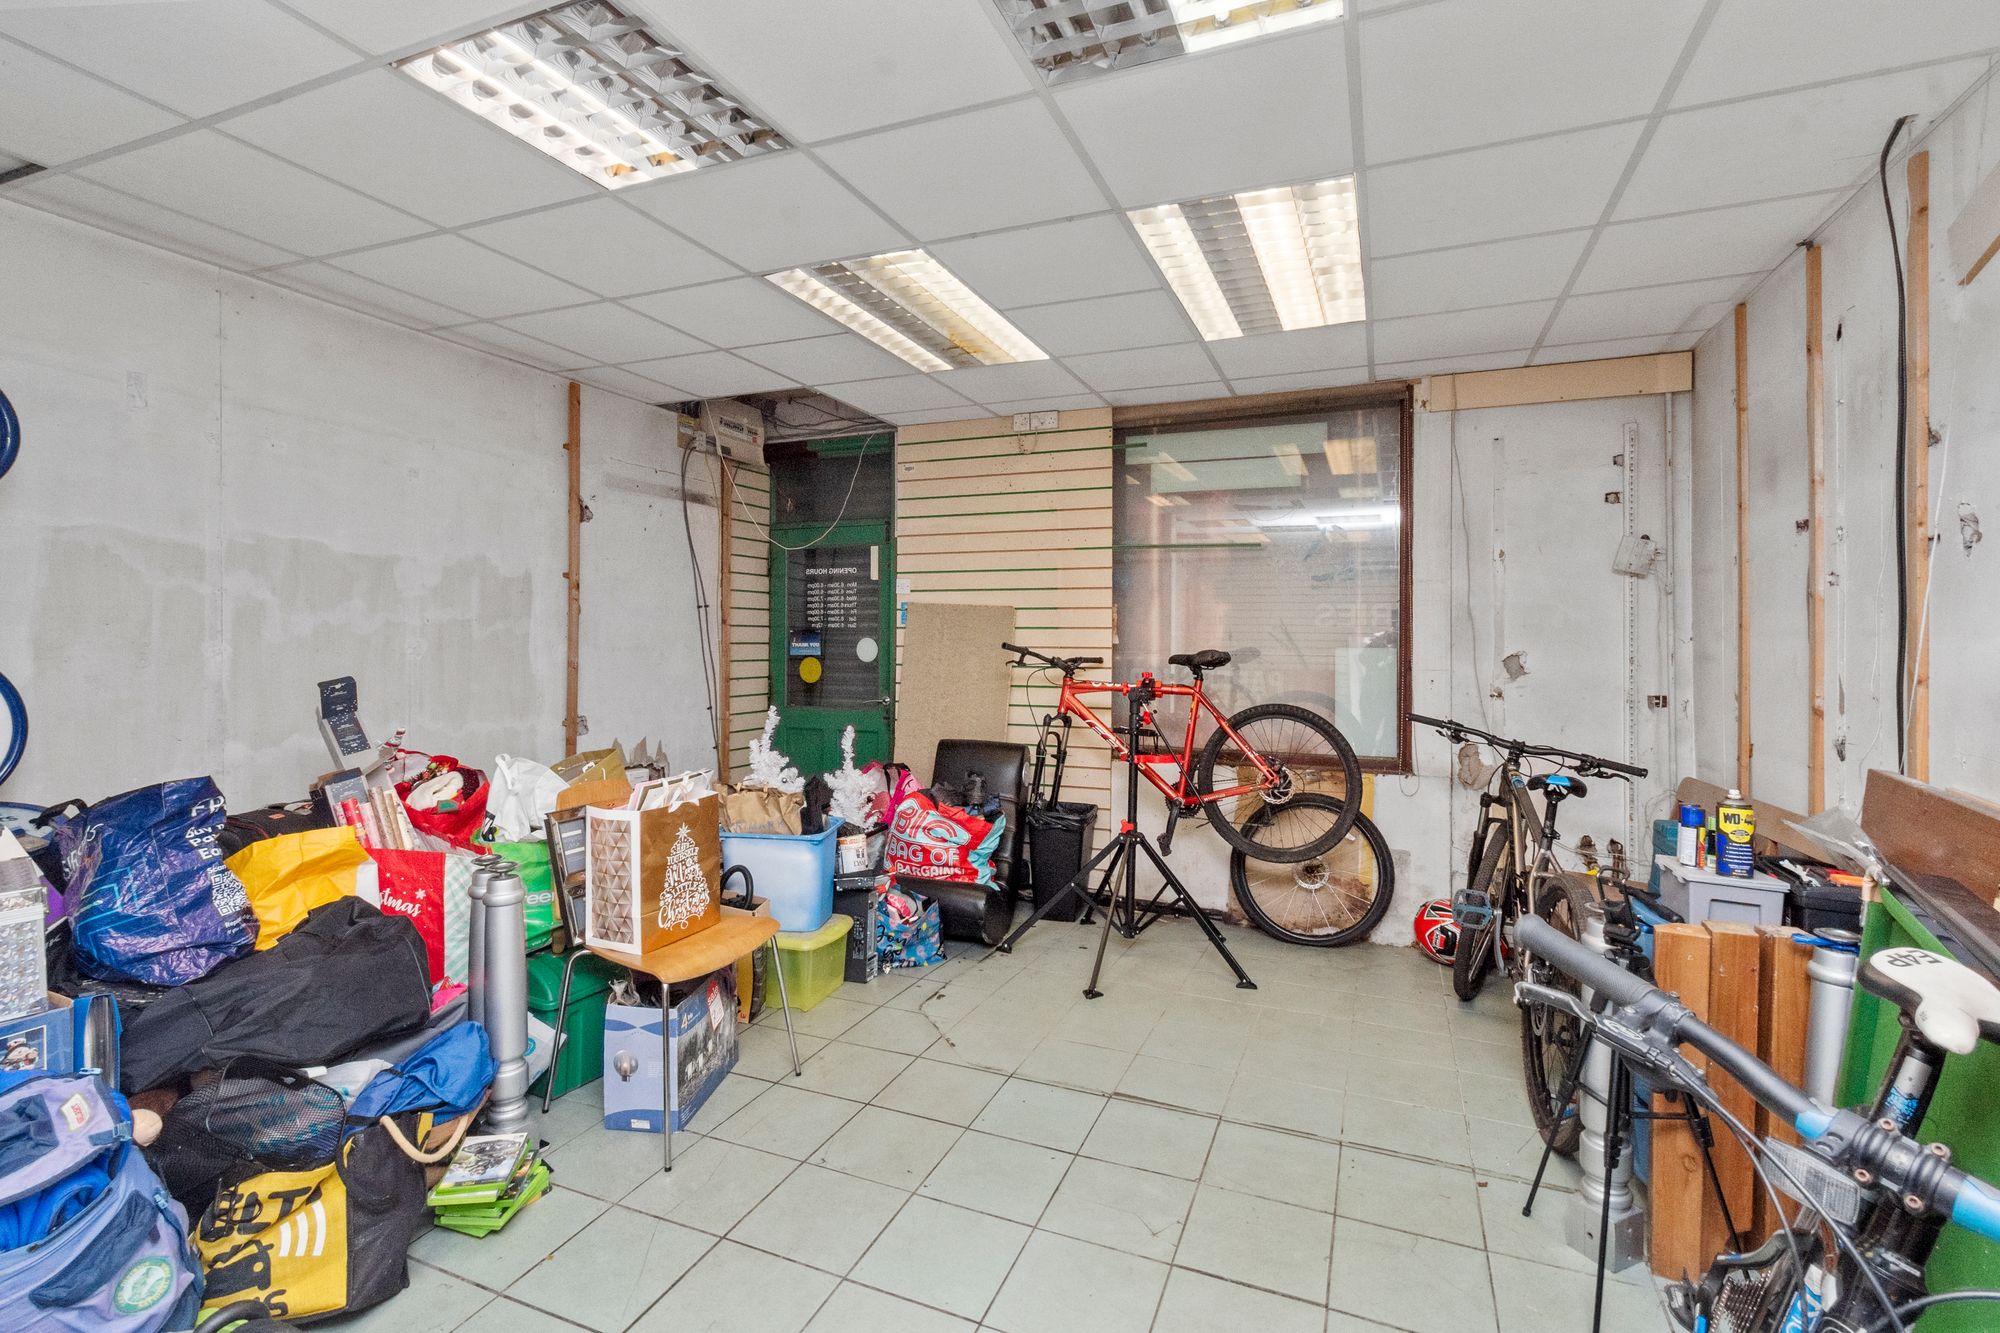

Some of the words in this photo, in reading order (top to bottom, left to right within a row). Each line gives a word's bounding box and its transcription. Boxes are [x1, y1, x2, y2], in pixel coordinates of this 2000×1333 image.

[185, 826, 212, 839] Buy
[889, 836, 924, 863] BAG
[930, 848, 960, 867] OF
